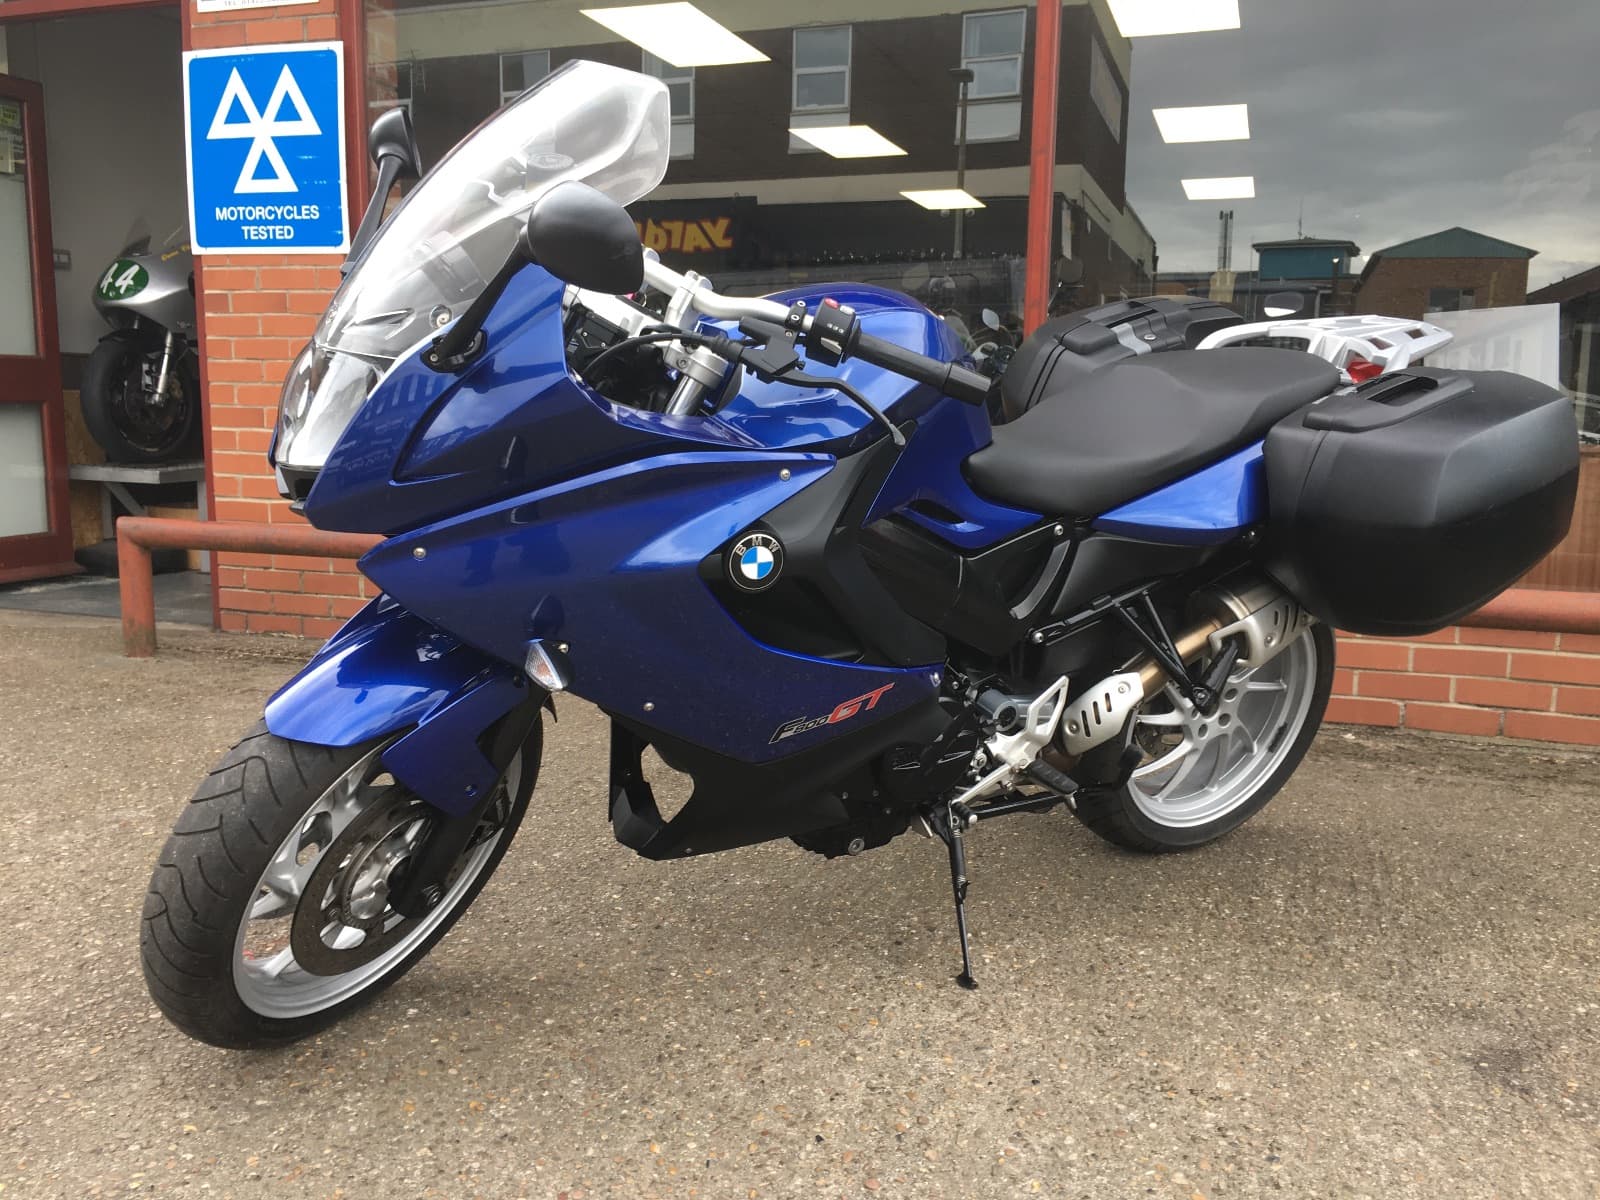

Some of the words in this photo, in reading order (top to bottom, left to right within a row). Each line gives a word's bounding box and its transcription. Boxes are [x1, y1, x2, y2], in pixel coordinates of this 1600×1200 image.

[214, 205, 320, 221] MOTORCYCLES
[241, 225, 295, 240] TESTED
[100, 262, 140, 294] 44
[735, 535, 780, 556] BMW
